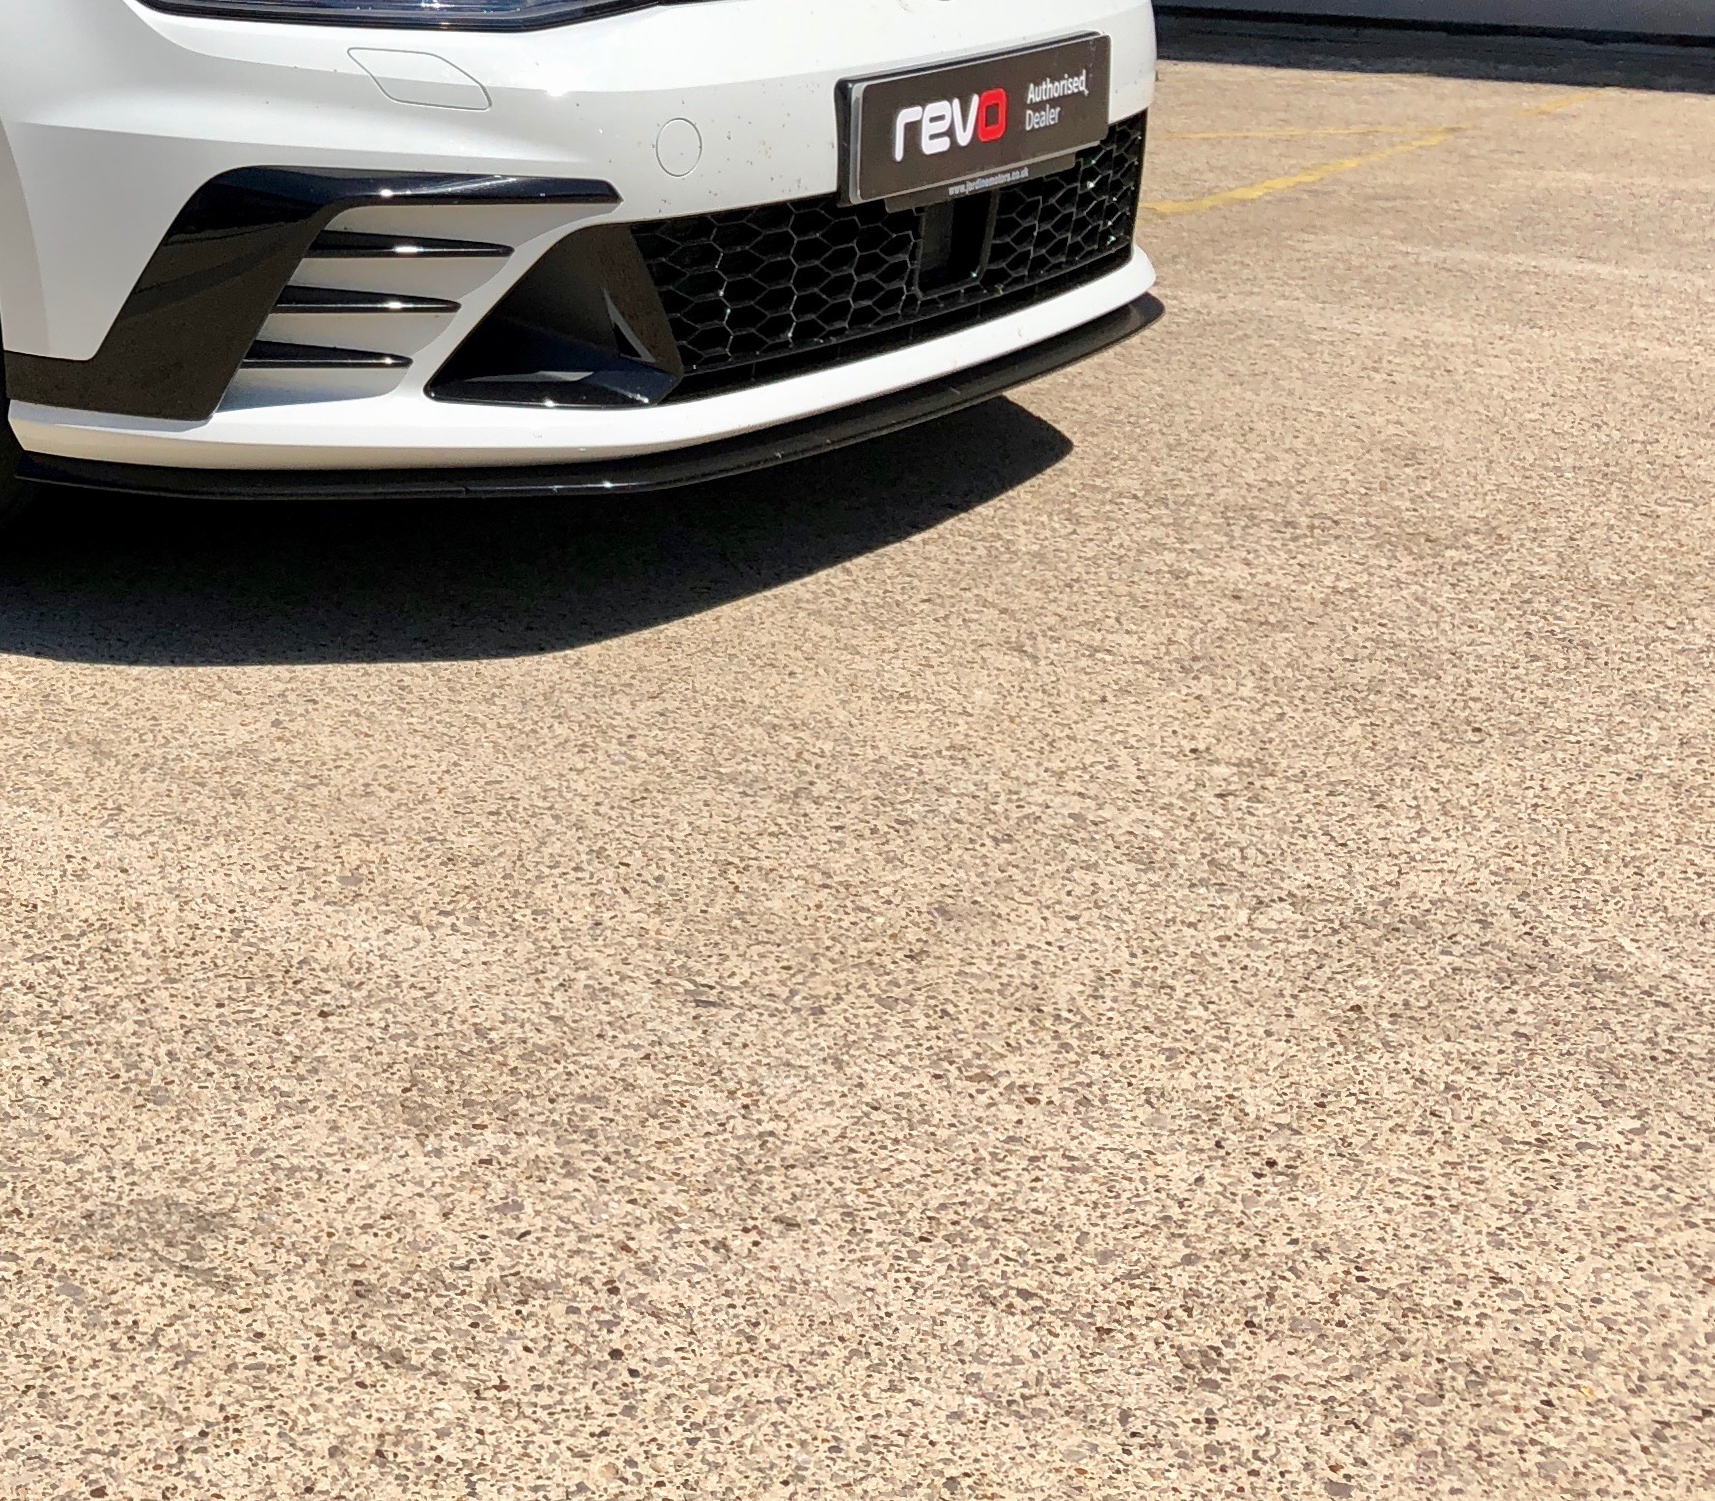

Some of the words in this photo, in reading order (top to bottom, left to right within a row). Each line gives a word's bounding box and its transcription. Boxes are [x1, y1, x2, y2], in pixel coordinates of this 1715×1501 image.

[1026, 69, 1087, 105] Authorised
[894, 87, 1008, 162] revo
[1025, 104, 1061, 131] Dealer
